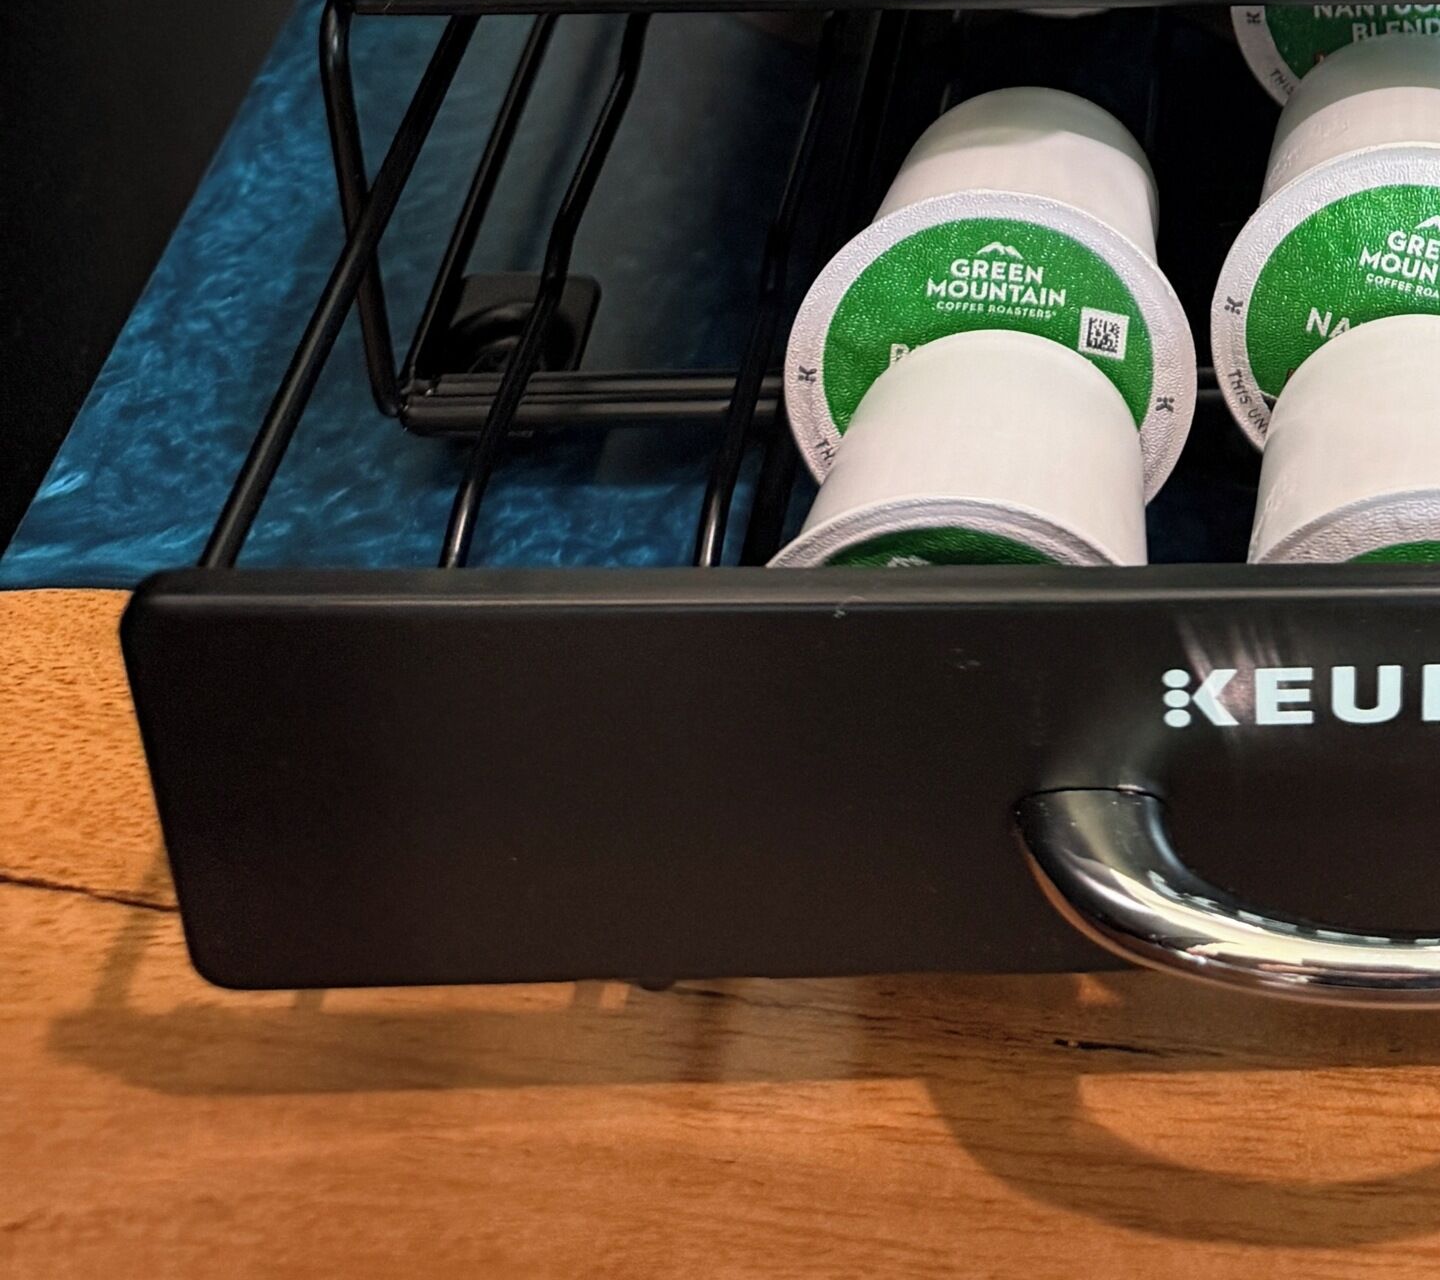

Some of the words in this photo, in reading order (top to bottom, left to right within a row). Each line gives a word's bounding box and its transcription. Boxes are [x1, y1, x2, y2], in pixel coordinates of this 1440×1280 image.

[950, 258, 1043, 285] GREEN
[1366, 272, 1412, 292] COFFEE
[926, 277, 1066, 307] MOUNTAIN
[936, 300, 984, 314] COFFEE
[1227, 369, 1252, 405] THIS
